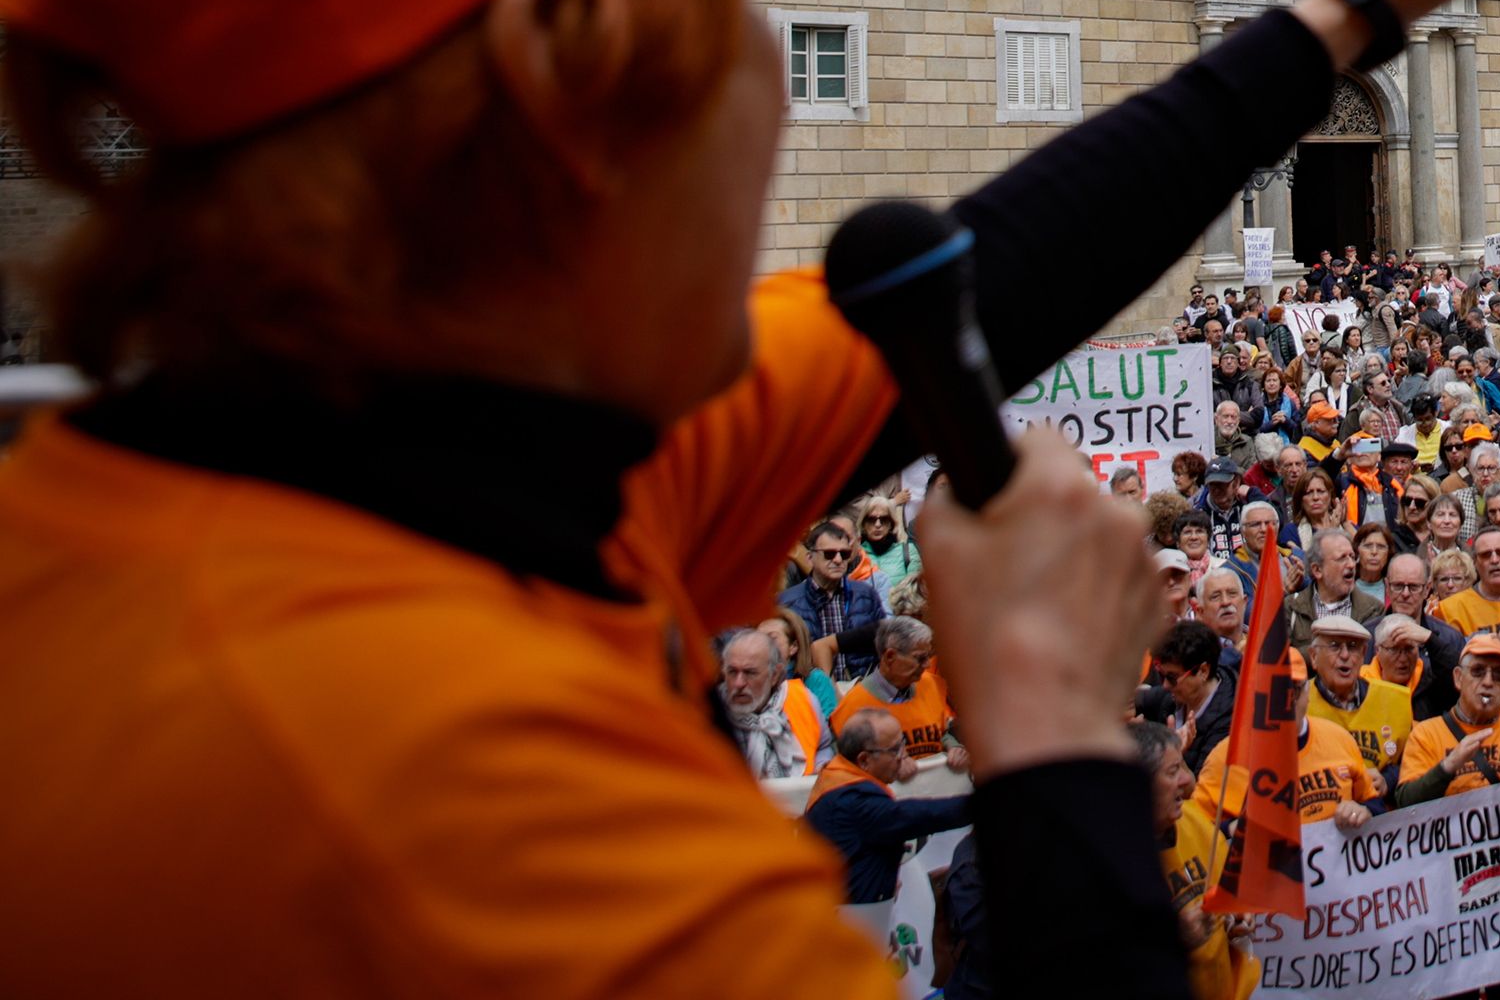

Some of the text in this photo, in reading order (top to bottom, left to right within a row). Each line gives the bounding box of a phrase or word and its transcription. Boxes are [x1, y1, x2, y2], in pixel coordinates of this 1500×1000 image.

[1026, 401, 1194, 449] OSTRE
[1340, 827, 1403, 877] 100%
[1458, 895, 1499, 915] SANT
[1261, 954, 1305, 990] ELS
[1310, 945, 1382, 990] DRETS
[1390, 935, 1418, 978] ES
